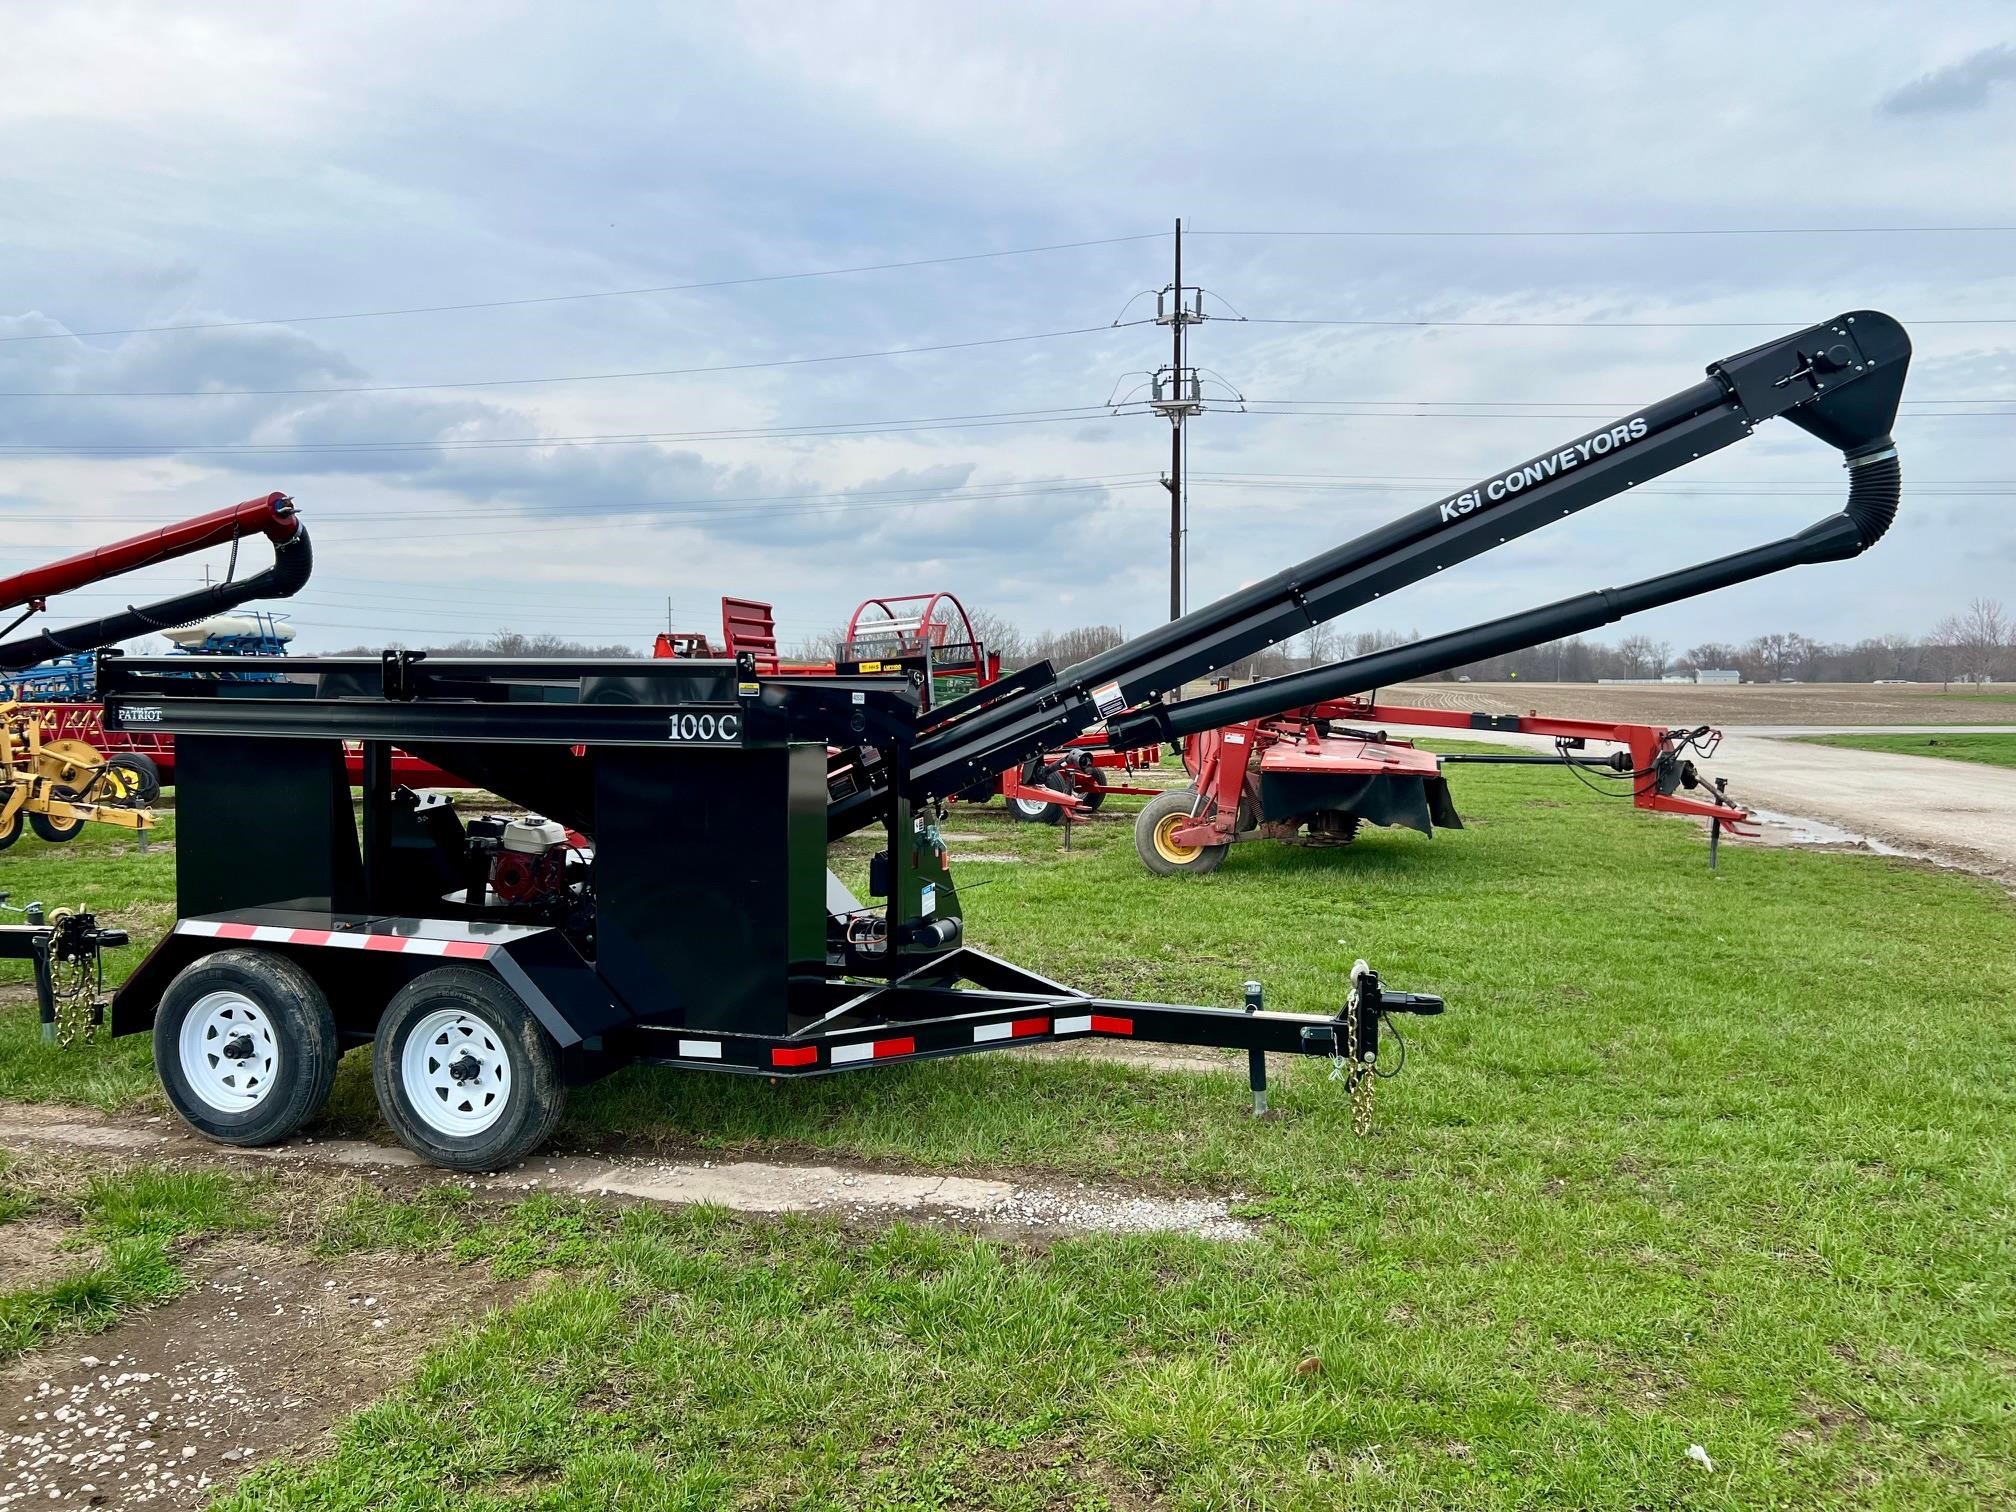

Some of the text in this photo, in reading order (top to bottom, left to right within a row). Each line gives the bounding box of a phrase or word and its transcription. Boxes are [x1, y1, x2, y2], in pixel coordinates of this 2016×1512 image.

[1439, 417, 1648, 523] KSi CONVEYORS
[118, 709, 163, 720] PATRIOT
[668, 713, 738, 740] 100C
